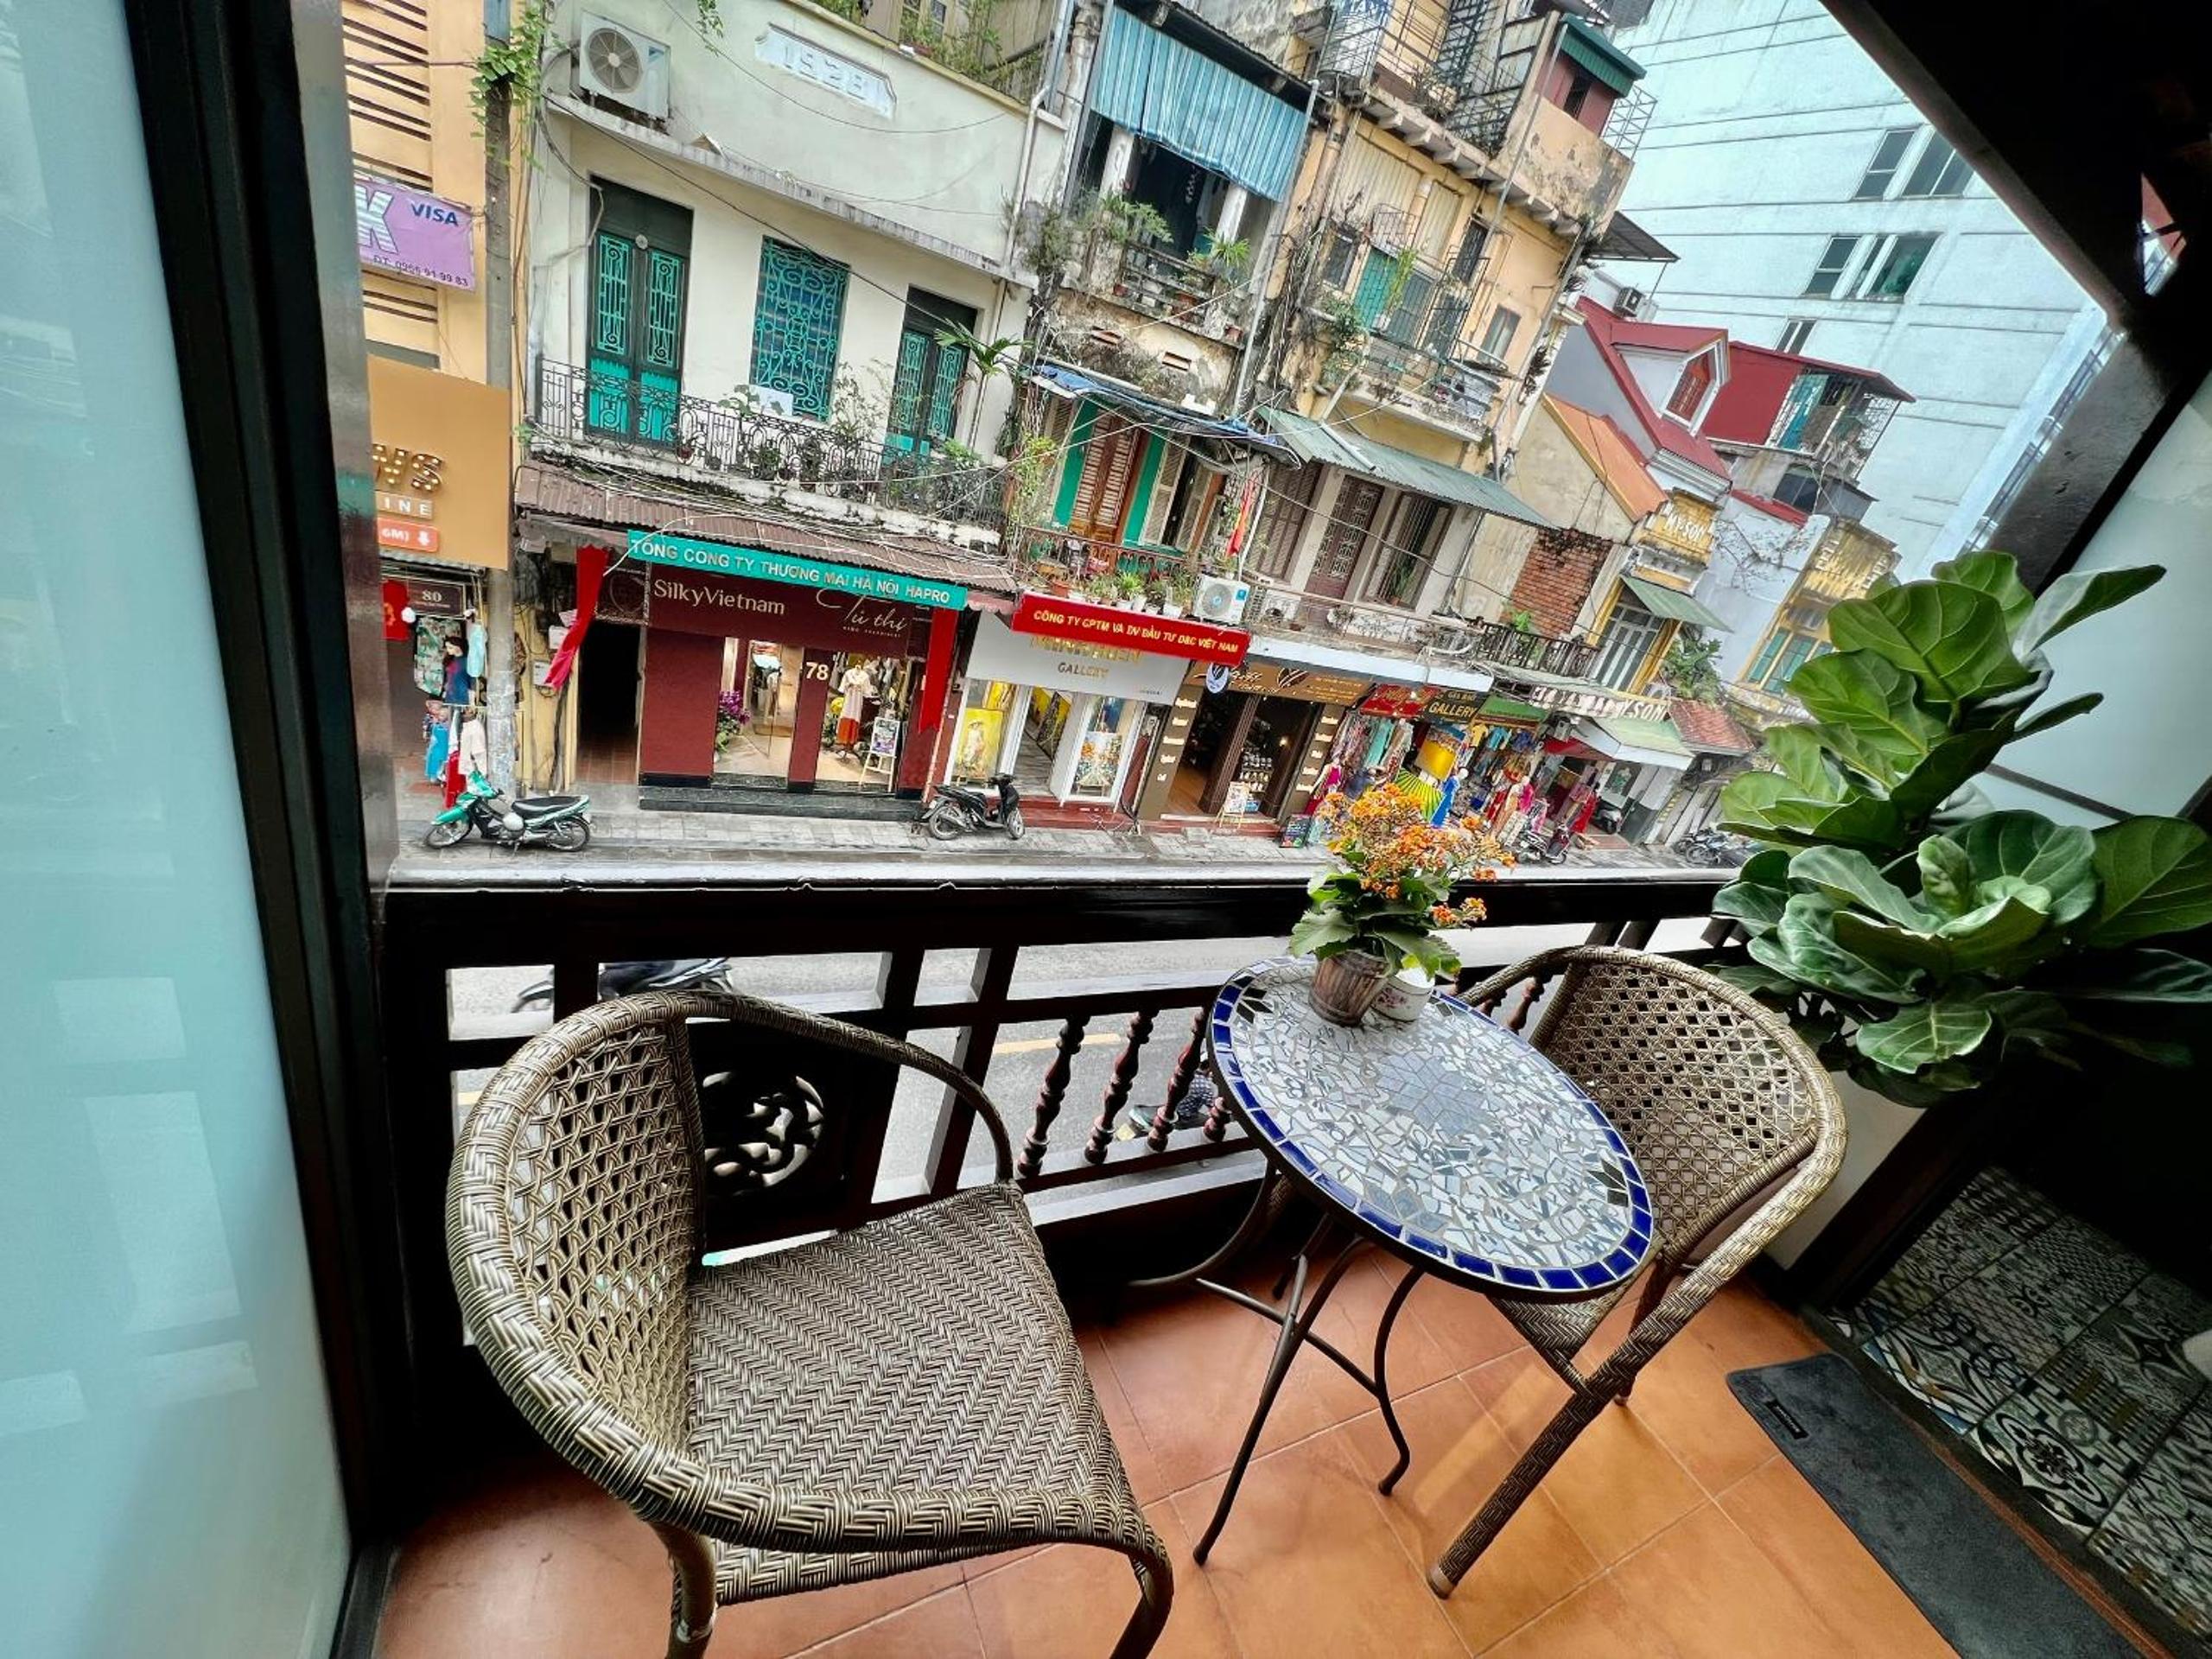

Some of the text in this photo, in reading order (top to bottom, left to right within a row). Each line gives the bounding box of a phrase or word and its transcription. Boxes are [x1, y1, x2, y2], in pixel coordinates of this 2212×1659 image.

[410, 203, 459, 226] VISA
[735, 556, 754, 571] TY
[760, 563, 819, 582] THƯƠNG
[823, 572, 849, 588] MẠI
[905, 585, 950, 604] HAPRO
[422, 589, 443, 603] 80
[1033, 609, 1065, 625] CÔNG
[1067, 615, 1081, 626] TY
[1217, 641, 1239, 653] NAM
[805, 661, 830, 681] 78
[1428, 701, 1478, 718] GALLERY
